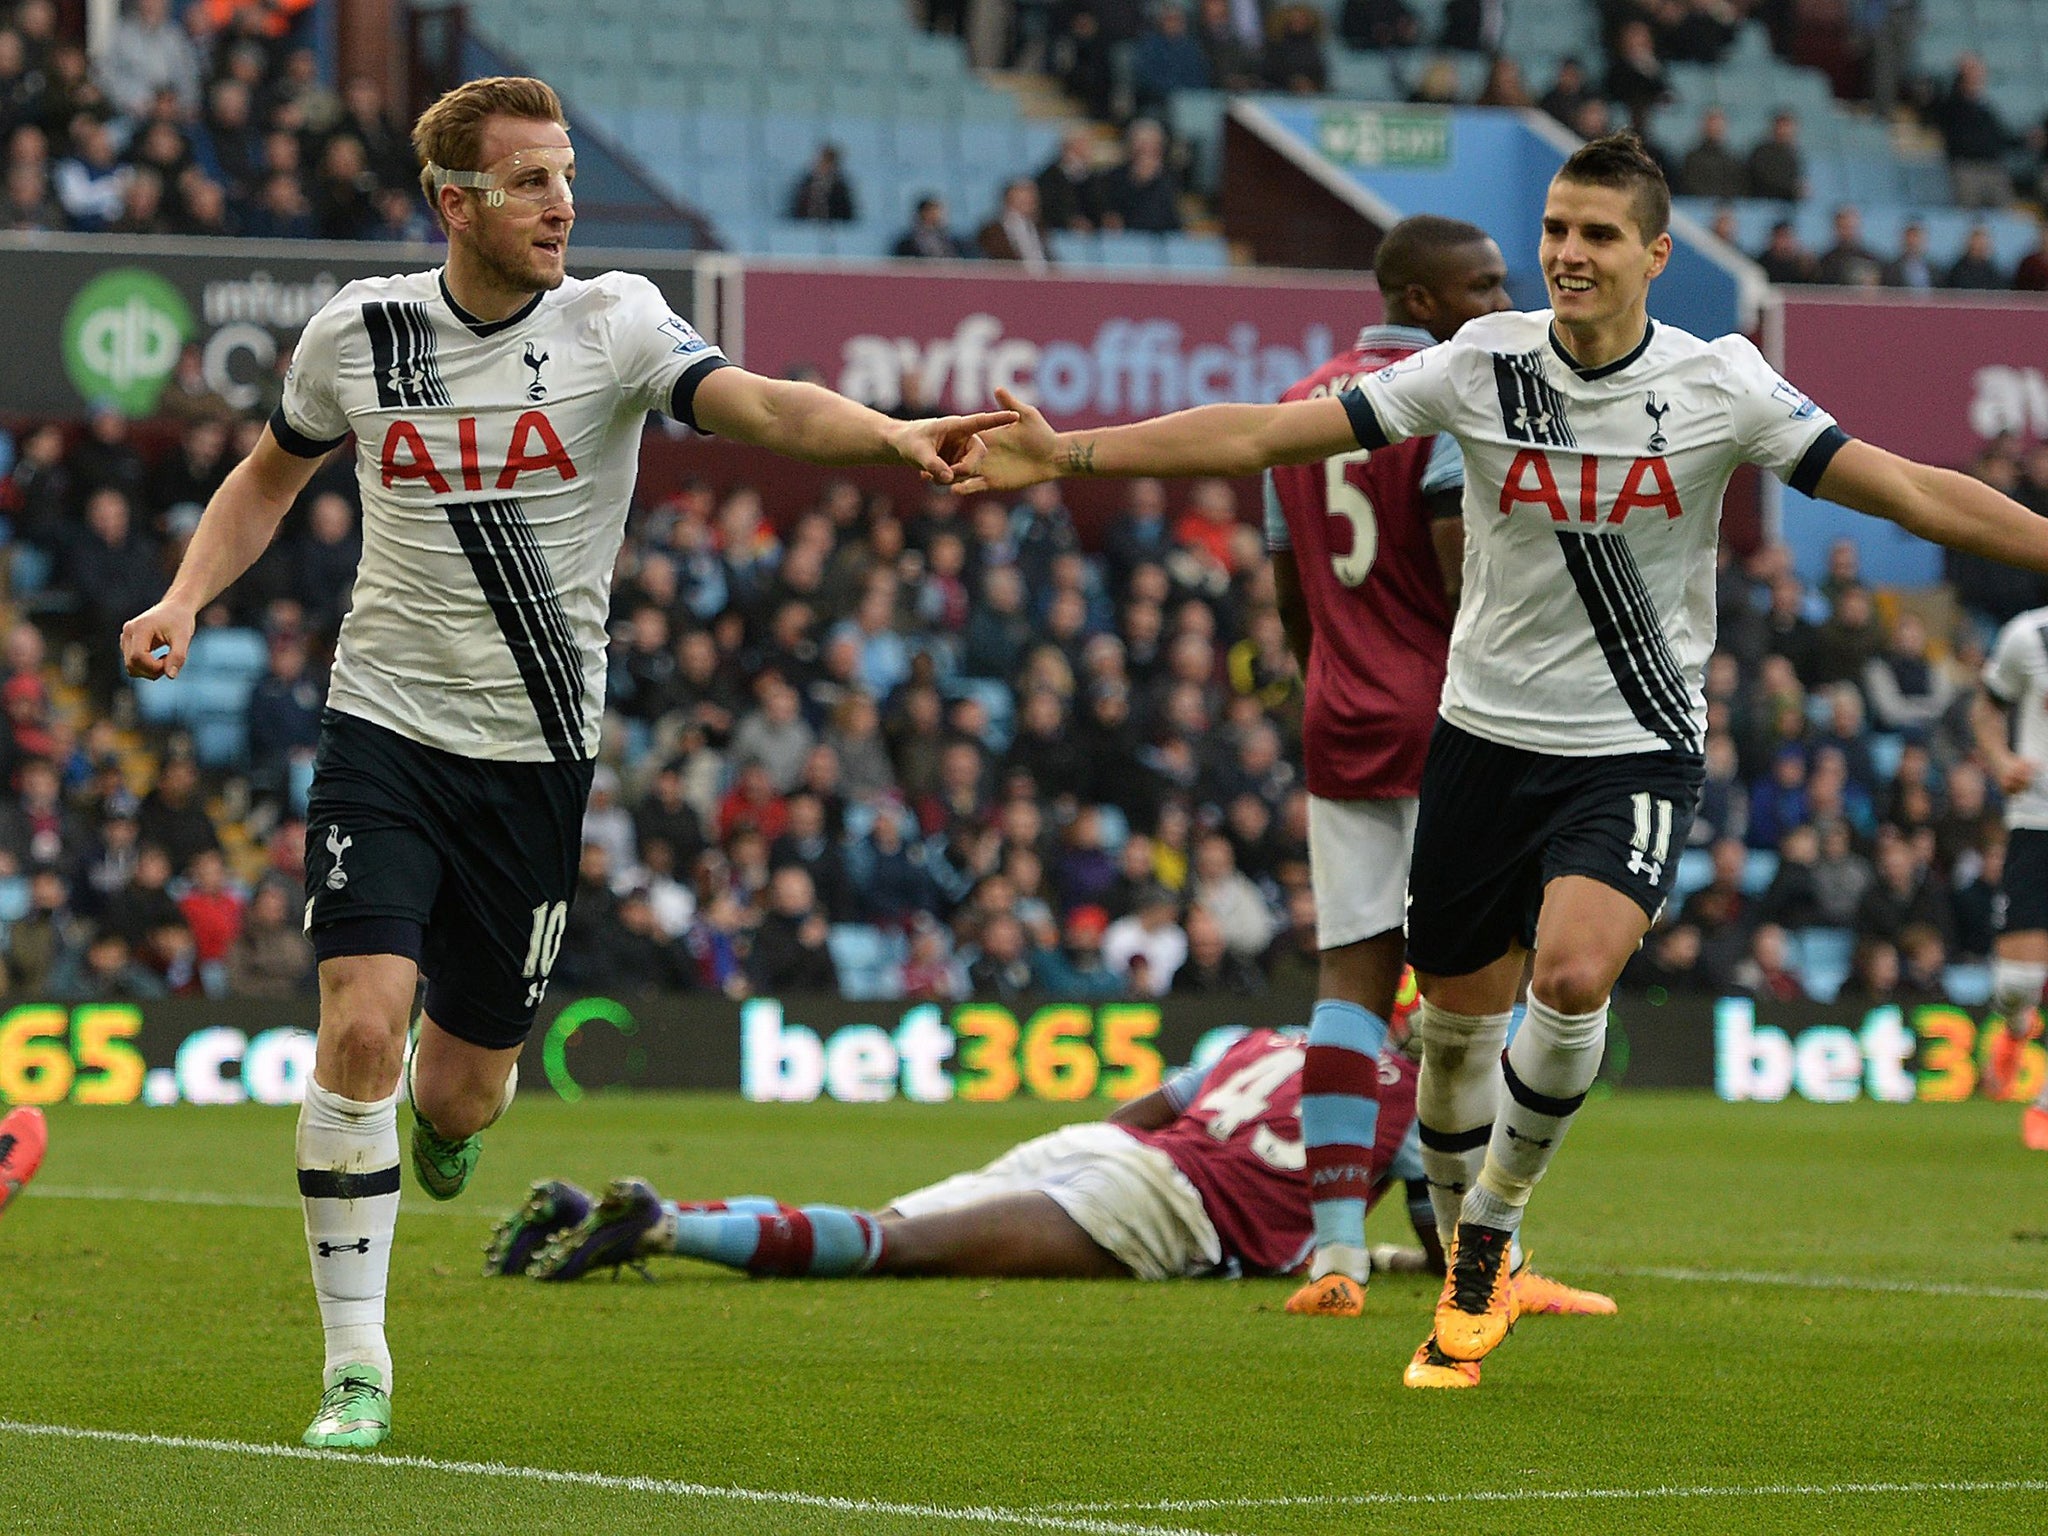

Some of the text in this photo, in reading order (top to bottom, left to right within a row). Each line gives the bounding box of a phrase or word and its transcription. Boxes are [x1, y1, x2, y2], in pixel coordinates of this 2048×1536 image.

[485, 189, 505, 208] 10
[380, 410, 578, 494] AIA
[1499, 448, 1683, 524] AIA
[1325, 447, 1378, 588] 5
[1629, 791, 1673, 865] 11
[520, 900, 568, 978] 10
[0, 1002, 319, 1106] 65.co
[740, 998, 1252, 1103] bet365
